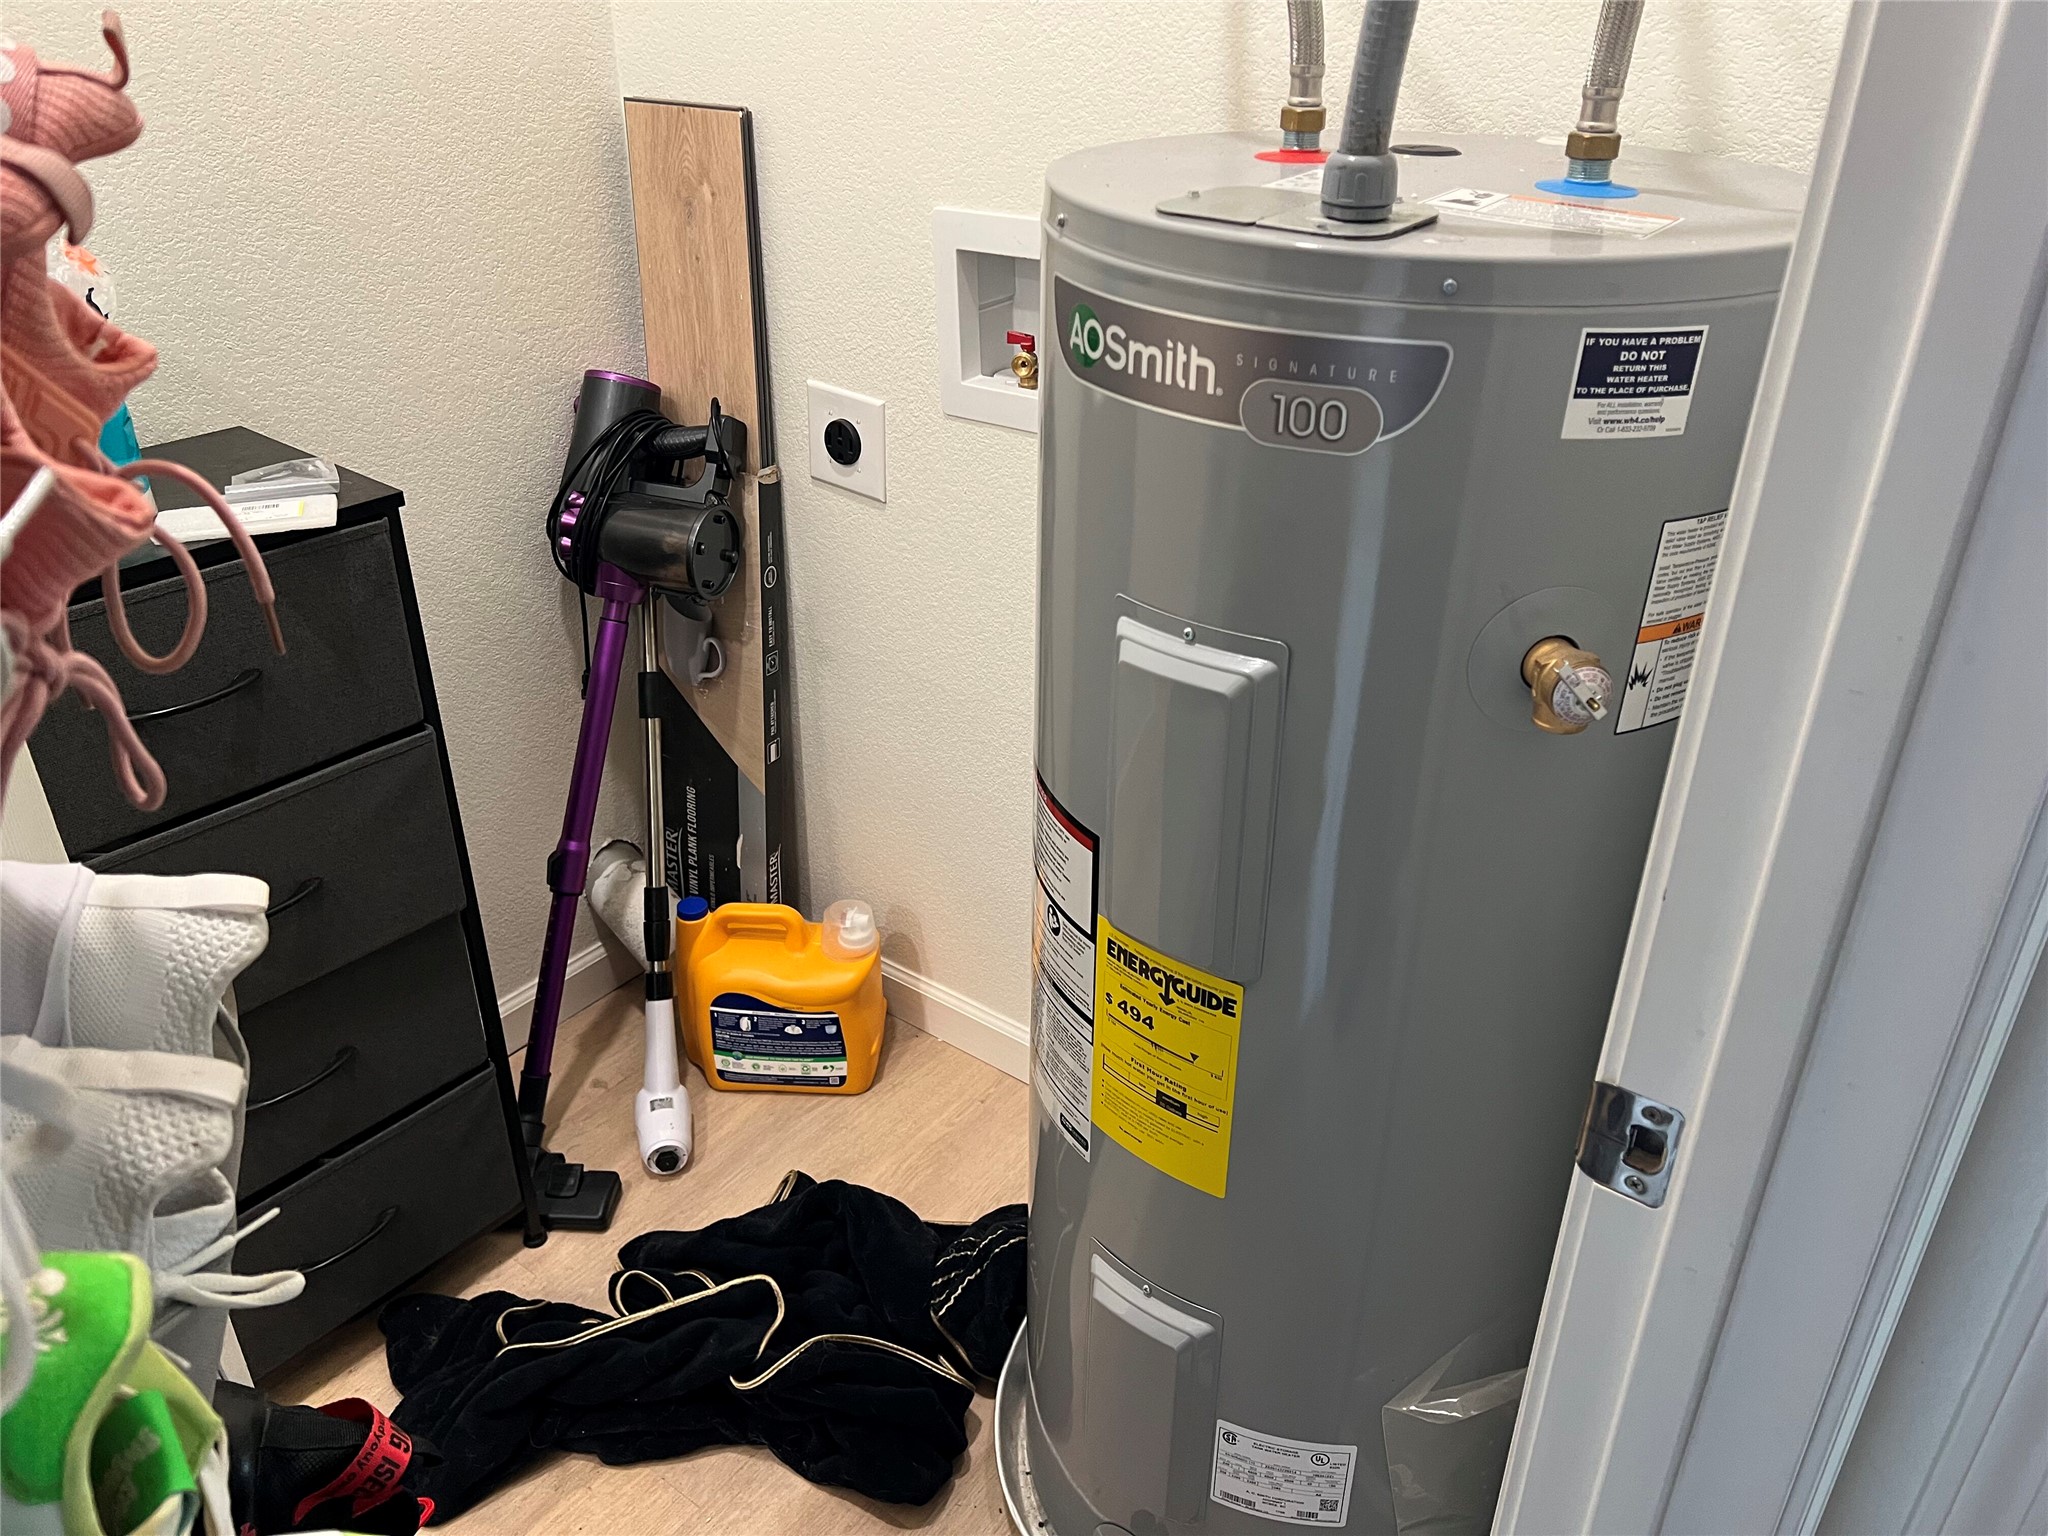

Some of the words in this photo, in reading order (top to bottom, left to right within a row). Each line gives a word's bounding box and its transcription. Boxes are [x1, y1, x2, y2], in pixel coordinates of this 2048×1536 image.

[1586, 338, 1595, 346] IF
[1599, 337, 1620, 346] YOU
[1622, 337, 1648, 346] HAVE
[1650, 337, 1657, 345] A
[1659, 335, 1701, 345] PROBLEM
[1613, 364, 1647, 372] RETURN
[1620, 351, 1638, 361] DO
[1641, 350, 1666, 361] NOT
[1236, 353, 1398, 384] SIGNATURE
[1606, 376, 1636, 384] WATER
[1637, 375, 1669, 383] HEATER
[1576, 387, 1588, 395] TO
[1608, 386, 1634, 394] PLACE
[1648, 384, 1690, 393] PURCHASE.
[1273, 393, 1348, 440] 100
[686, 785, 698, 834] FLOORING
[687, 835, 698, 866] PLANK
[689, 868, 699, 895] VINYL
[1105, 992, 1113, 1005] $
[1117, 1000, 1154, 1031] 494
[1143, 997, 1158, 1011] Yearly
[1159, 1008, 1177, 1021] Energy
[1131, 1057, 1145, 1070] First
[1147, 1067, 1163, 1079] Hour
[1164, 1076, 1187, 1093] Rating
[1172, 1086, 1181, 1095] the
[1182, 1091, 1193, 1101] first
[1194, 1097, 1207, 1107] hour
